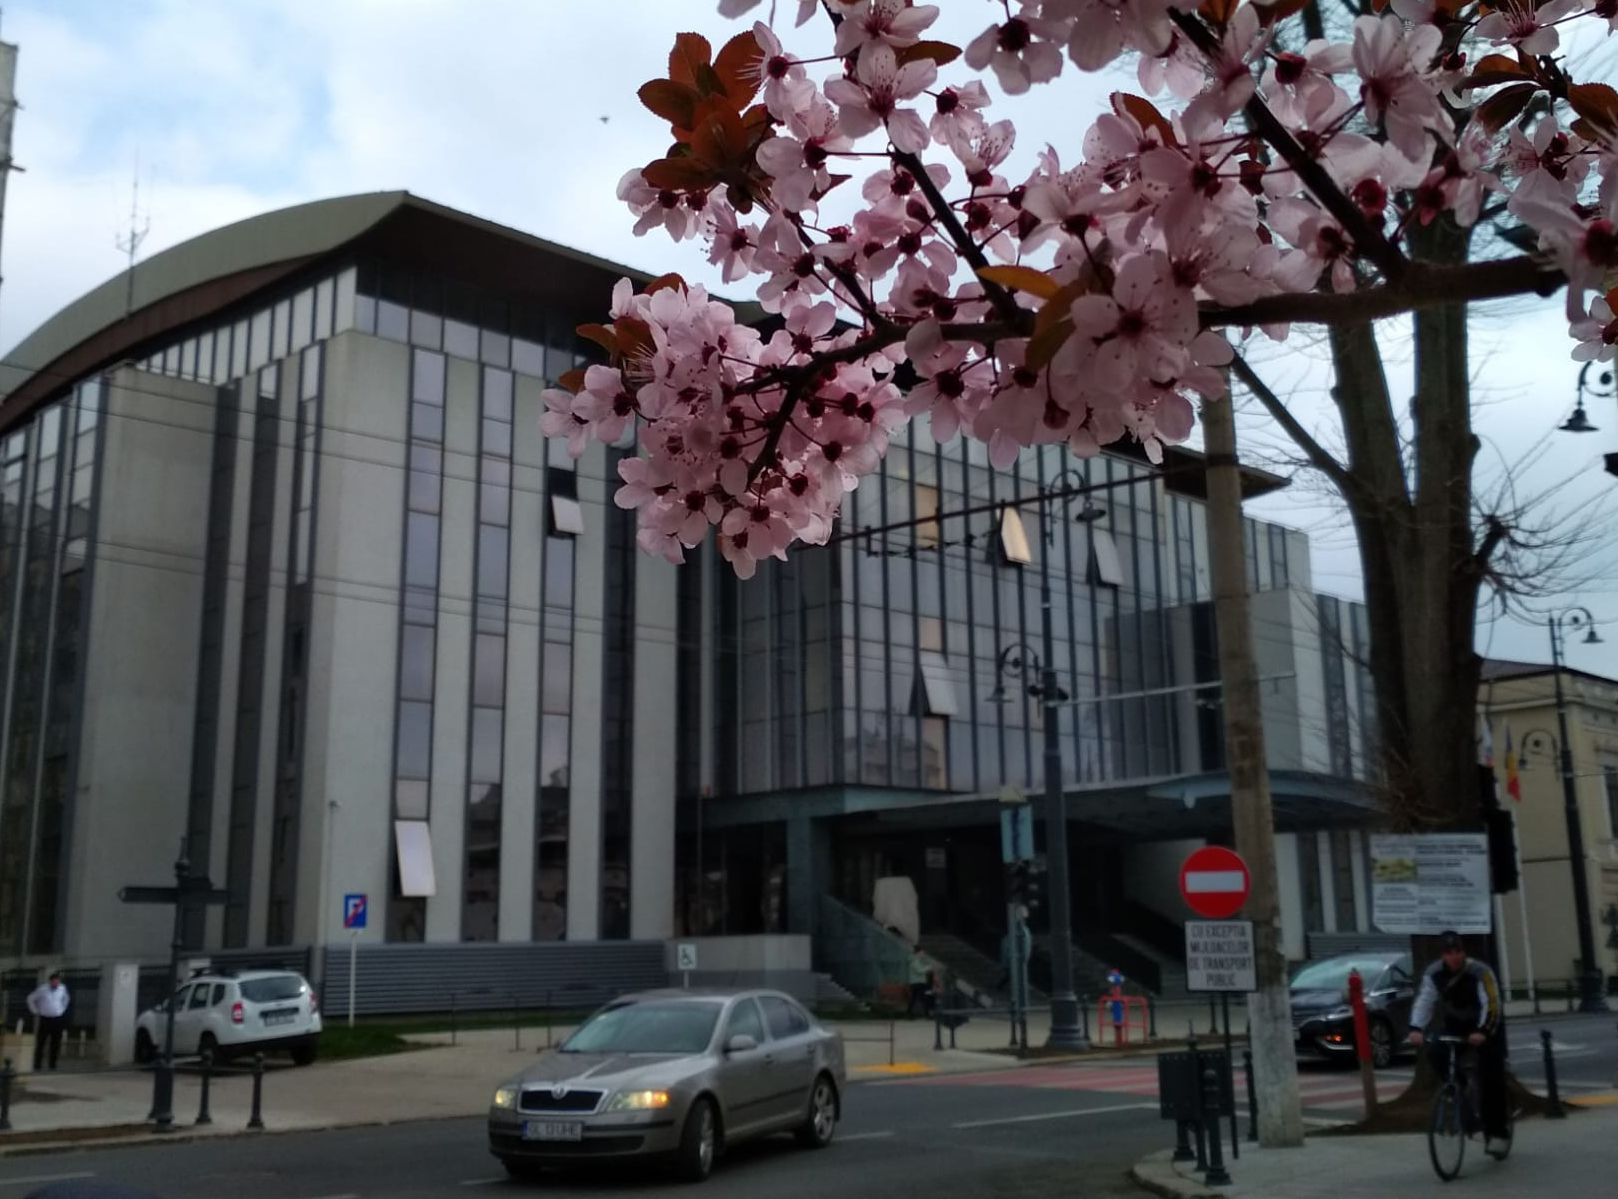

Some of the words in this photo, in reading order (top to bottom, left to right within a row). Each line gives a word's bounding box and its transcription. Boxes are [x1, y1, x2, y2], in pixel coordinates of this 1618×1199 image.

[1190, 925, 1204, 938] CU
[1188, 956, 1200, 970] DE
[1202, 956, 1252, 970] TRANSPORT
[1205, 972, 1236, 986] PUBLIC
